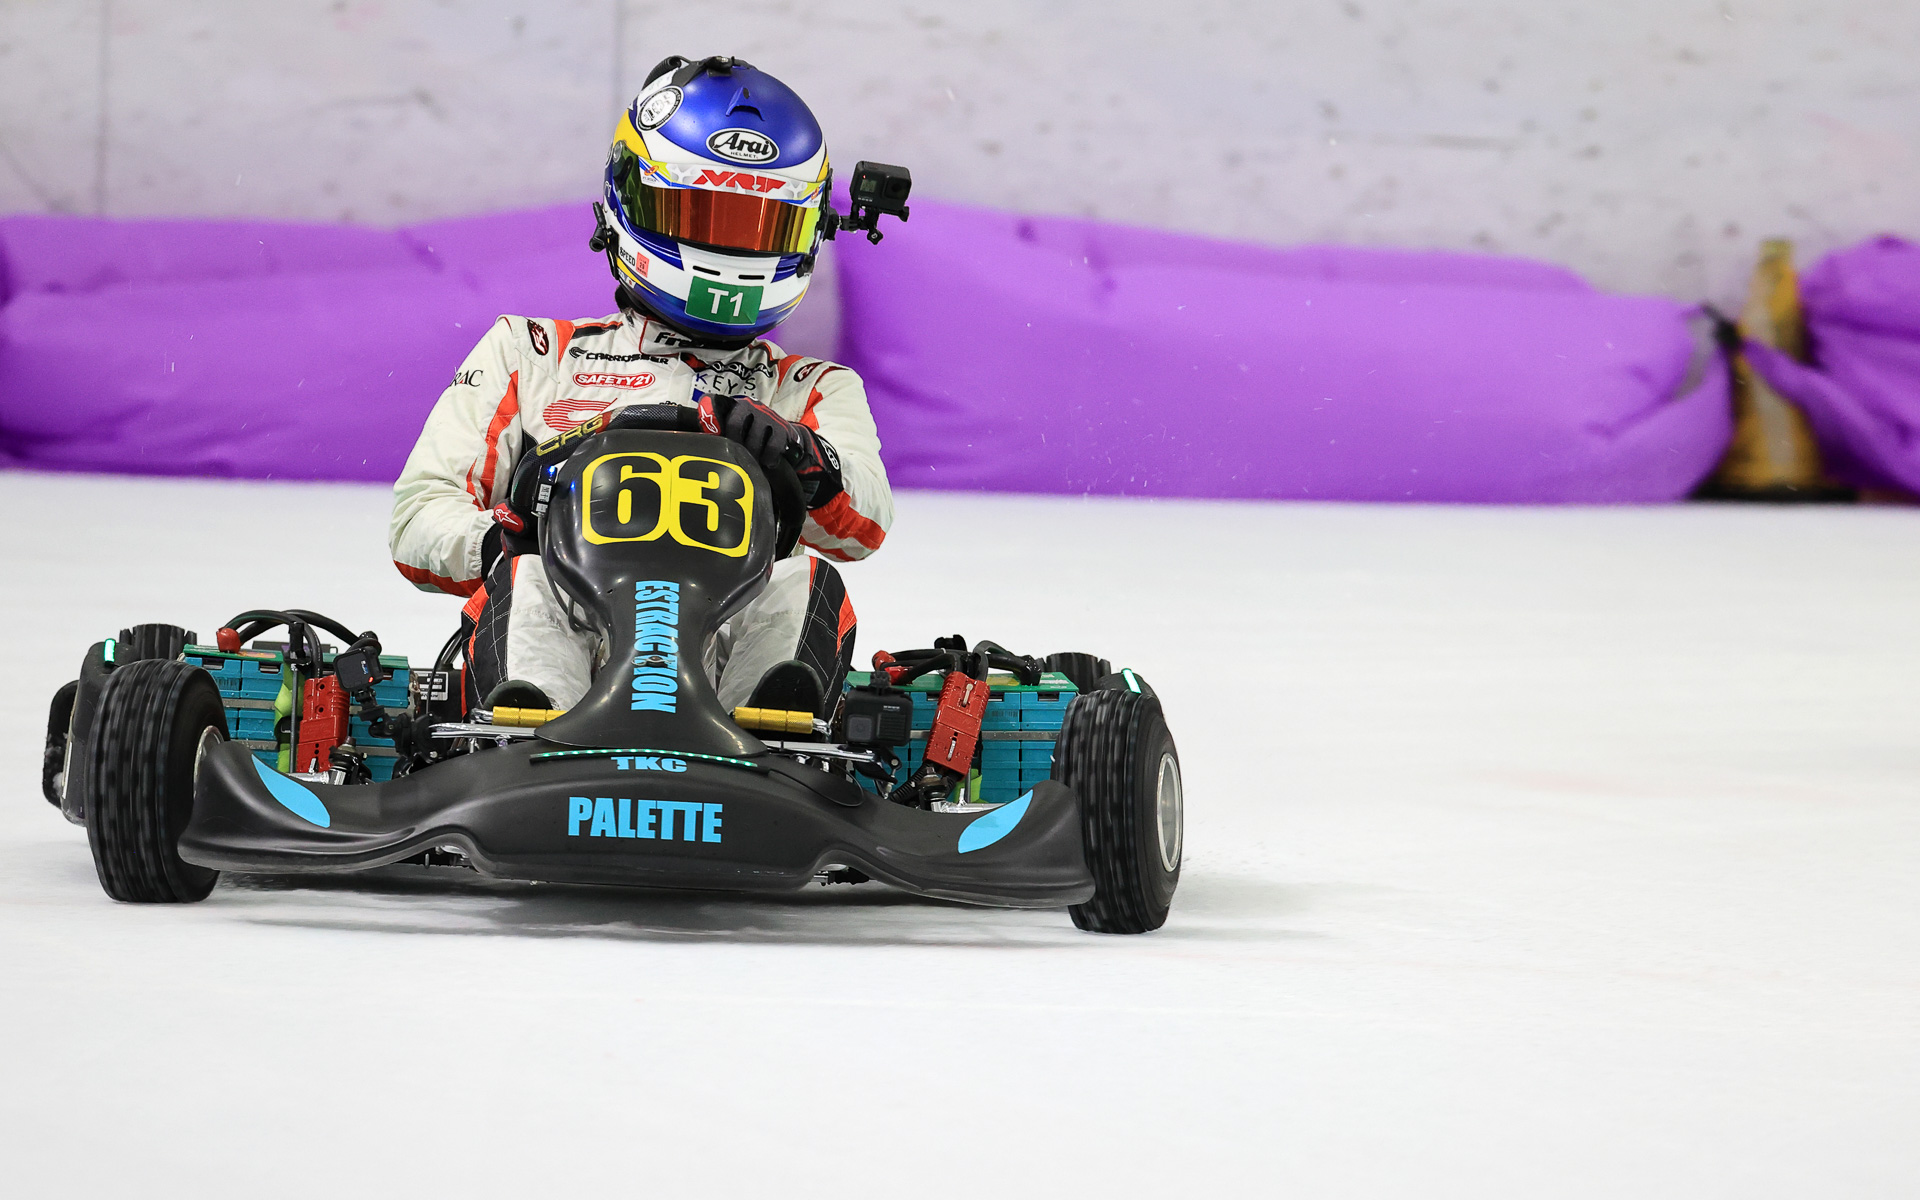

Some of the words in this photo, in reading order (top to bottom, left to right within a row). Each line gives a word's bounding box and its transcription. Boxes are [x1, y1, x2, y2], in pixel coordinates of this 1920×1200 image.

[713, 132, 770, 156] Arai
[730, 151, 757, 159] HELMET
[707, 287, 744, 317] T1
[694, 371, 758, 396] KEYS
[536, 414, 604, 457] CRG
[585, 453, 752, 555] 63
[631, 580, 680, 714] ESTRACTION
[610, 756, 688, 773] TKC
[567, 796, 723, 844] PALETTE
